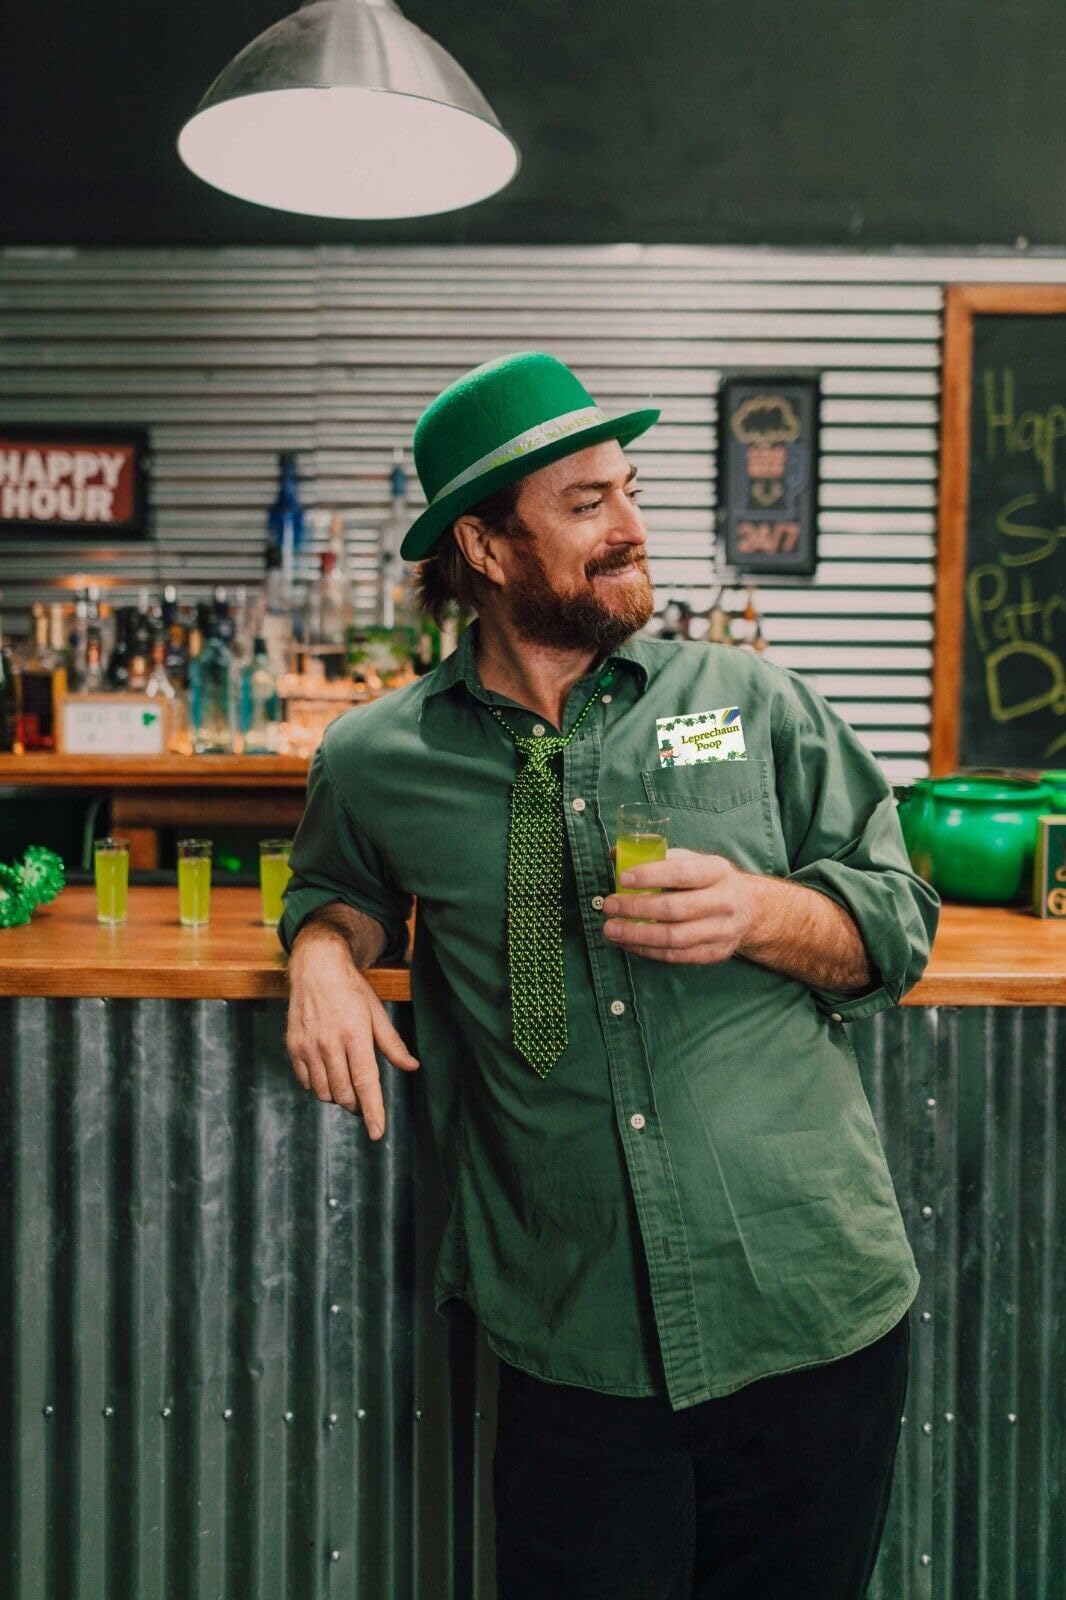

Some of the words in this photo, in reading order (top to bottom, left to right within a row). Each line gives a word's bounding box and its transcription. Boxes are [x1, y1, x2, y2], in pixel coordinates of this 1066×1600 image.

[0, 450, 125, 488] HAPPY
[3, 483, 114, 521] HOUR
[737, 521, 800, 555] 24/7
[681, 725, 740, 744] Leprechaun
[697, 739, 722, 751] Poop
